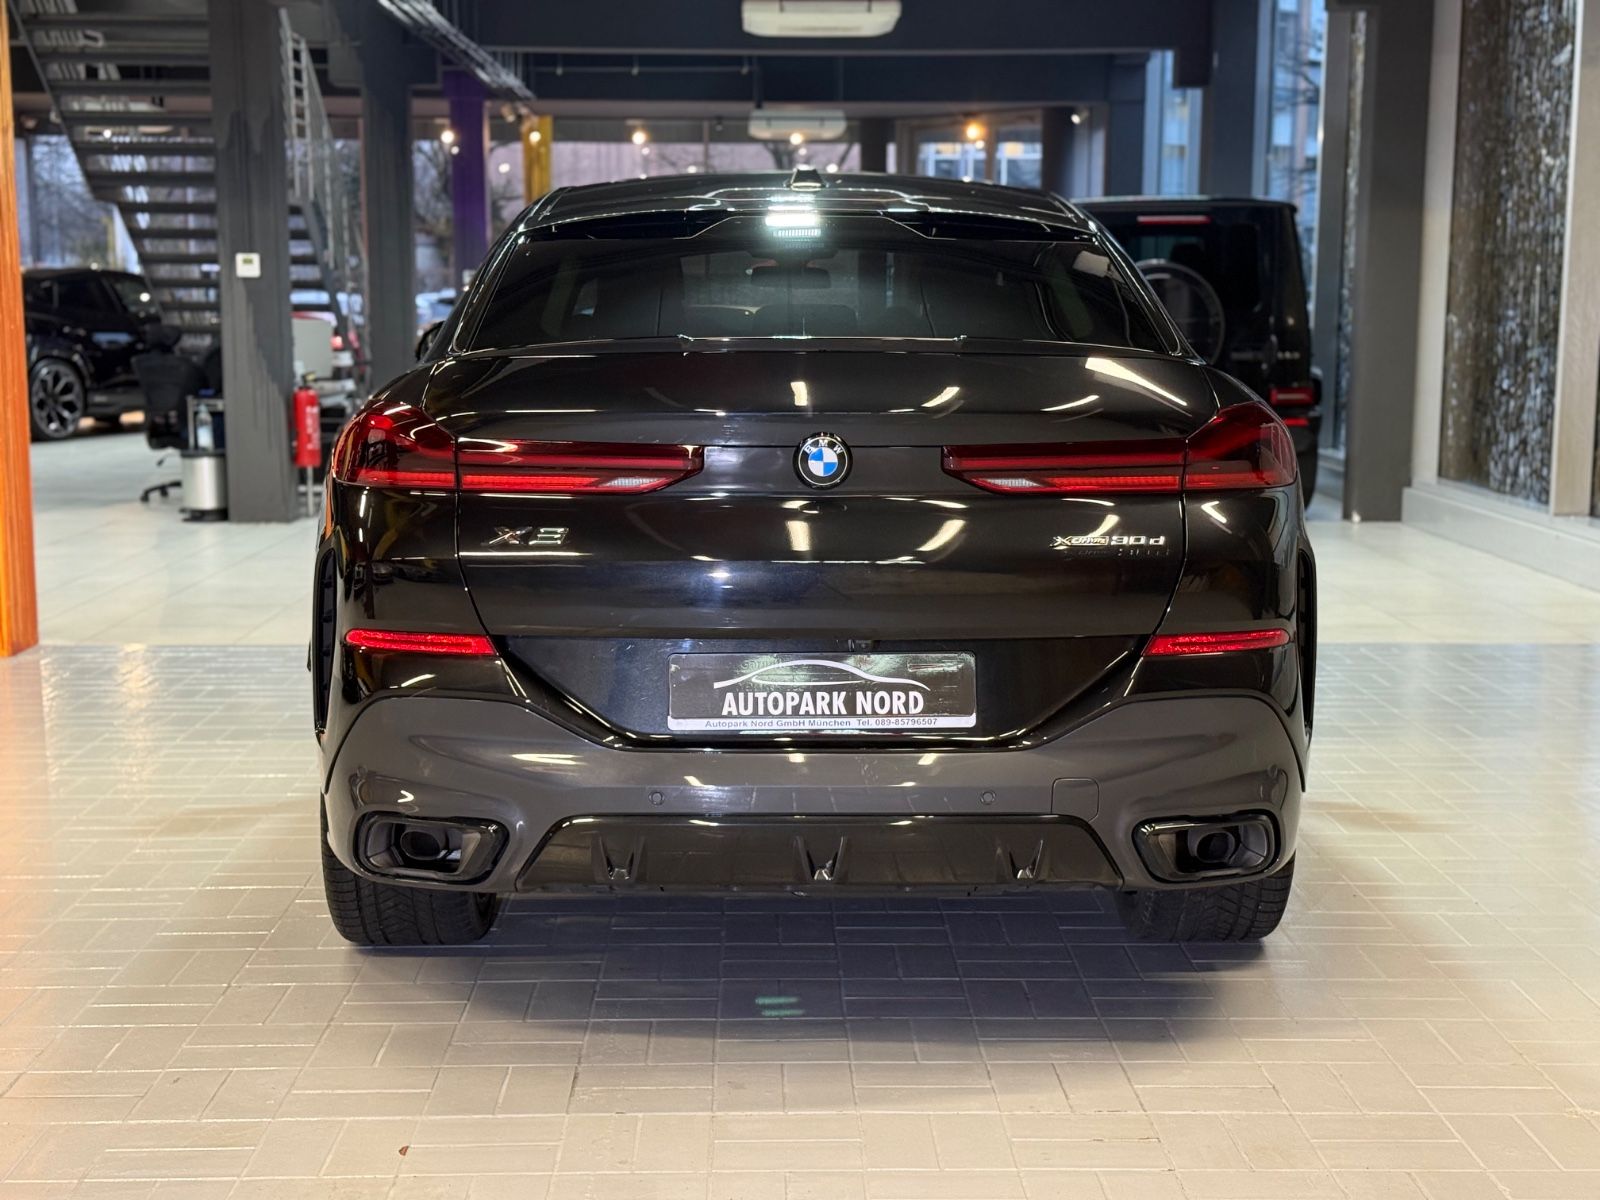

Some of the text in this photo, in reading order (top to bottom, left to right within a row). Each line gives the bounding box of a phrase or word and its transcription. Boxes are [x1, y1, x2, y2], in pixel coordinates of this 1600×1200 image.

[804, 439, 844, 454] BMW
[721, 690, 924, 716] AUTOPARK NORD
[705, 720, 748, 729] Autopark
[776, 719, 805, 727] GmbH
[808, 719, 851, 727] München
[857, 718, 872, 726] Tel.
[875, 718, 938, 726] 089-85796507
